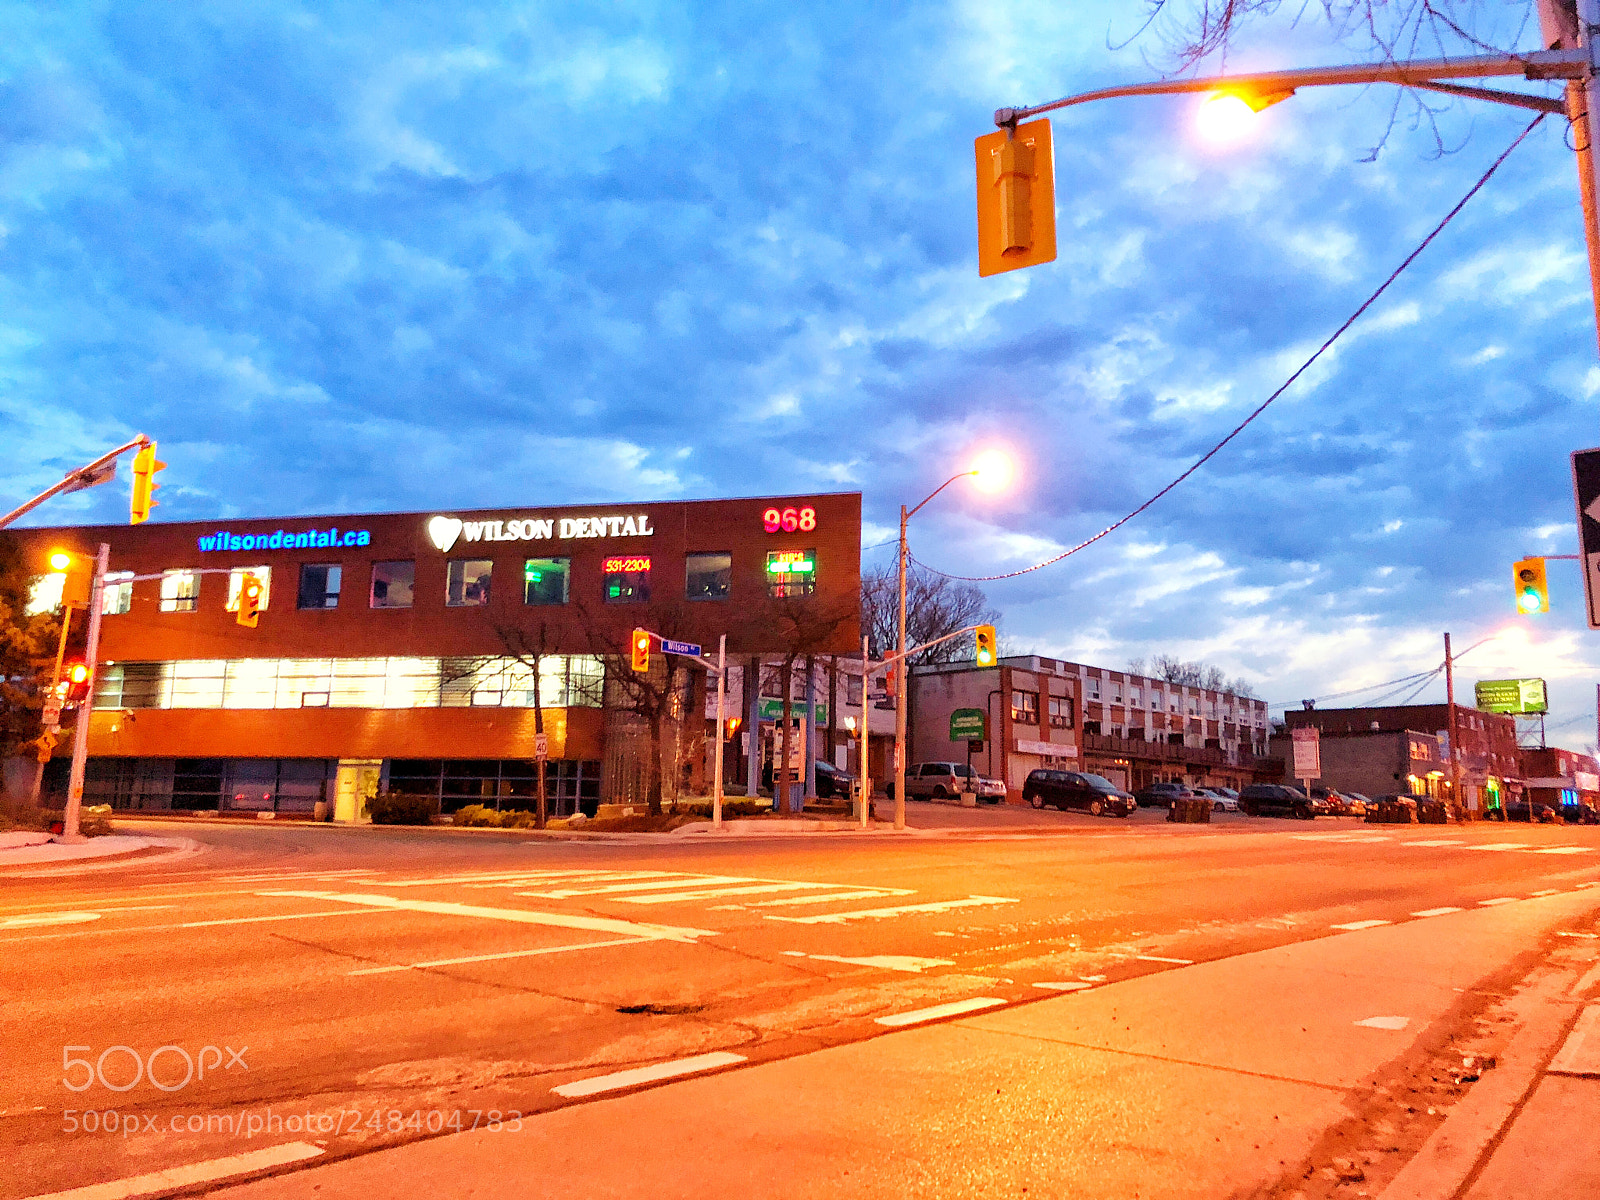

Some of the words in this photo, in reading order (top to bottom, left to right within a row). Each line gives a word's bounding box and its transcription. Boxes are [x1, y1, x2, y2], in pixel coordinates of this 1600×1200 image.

[464, 520, 553, 542] WILSON
[559, 515, 654, 538] DENTAL
[763, 507, 816, 533] 968
[198, 528, 371, 551] wilsondental.ca
[606, 558, 650, 572] 531-2304
[667, 640, 689, 652] Wilson
[536, 742, 547, 752] 40
